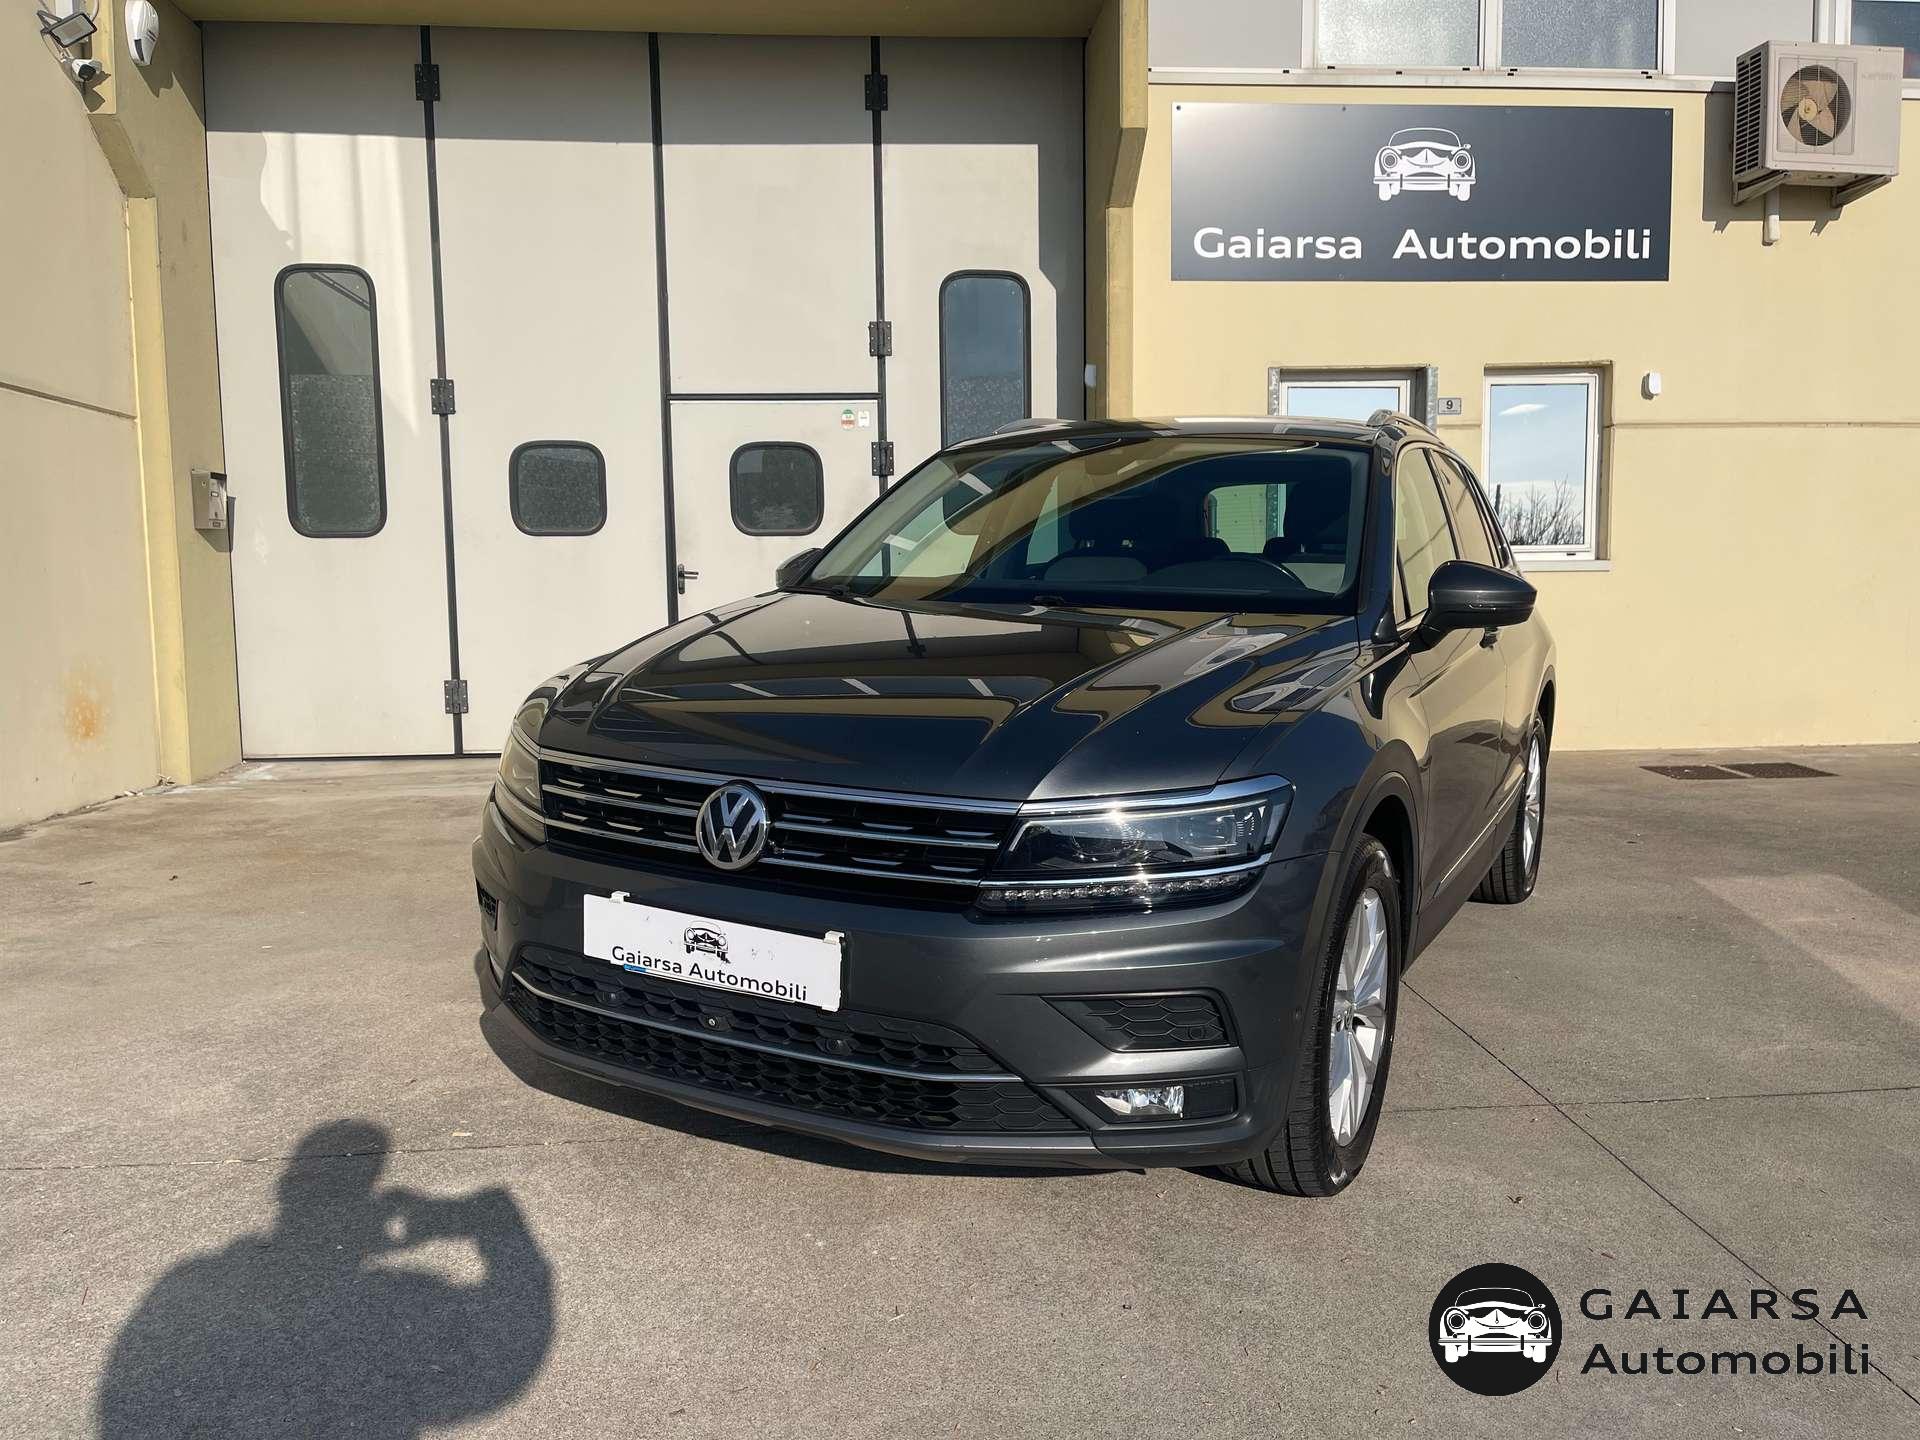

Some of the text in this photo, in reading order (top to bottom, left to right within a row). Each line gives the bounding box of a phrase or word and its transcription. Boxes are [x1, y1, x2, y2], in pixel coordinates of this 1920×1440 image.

[1193, 227, 1651, 261] Gaiarsa Automobili
[1446, 400, 1453, 409] 9
[700, 787, 764, 865] VW
[611, 945, 808, 1001] Gaiarsa Automobili
